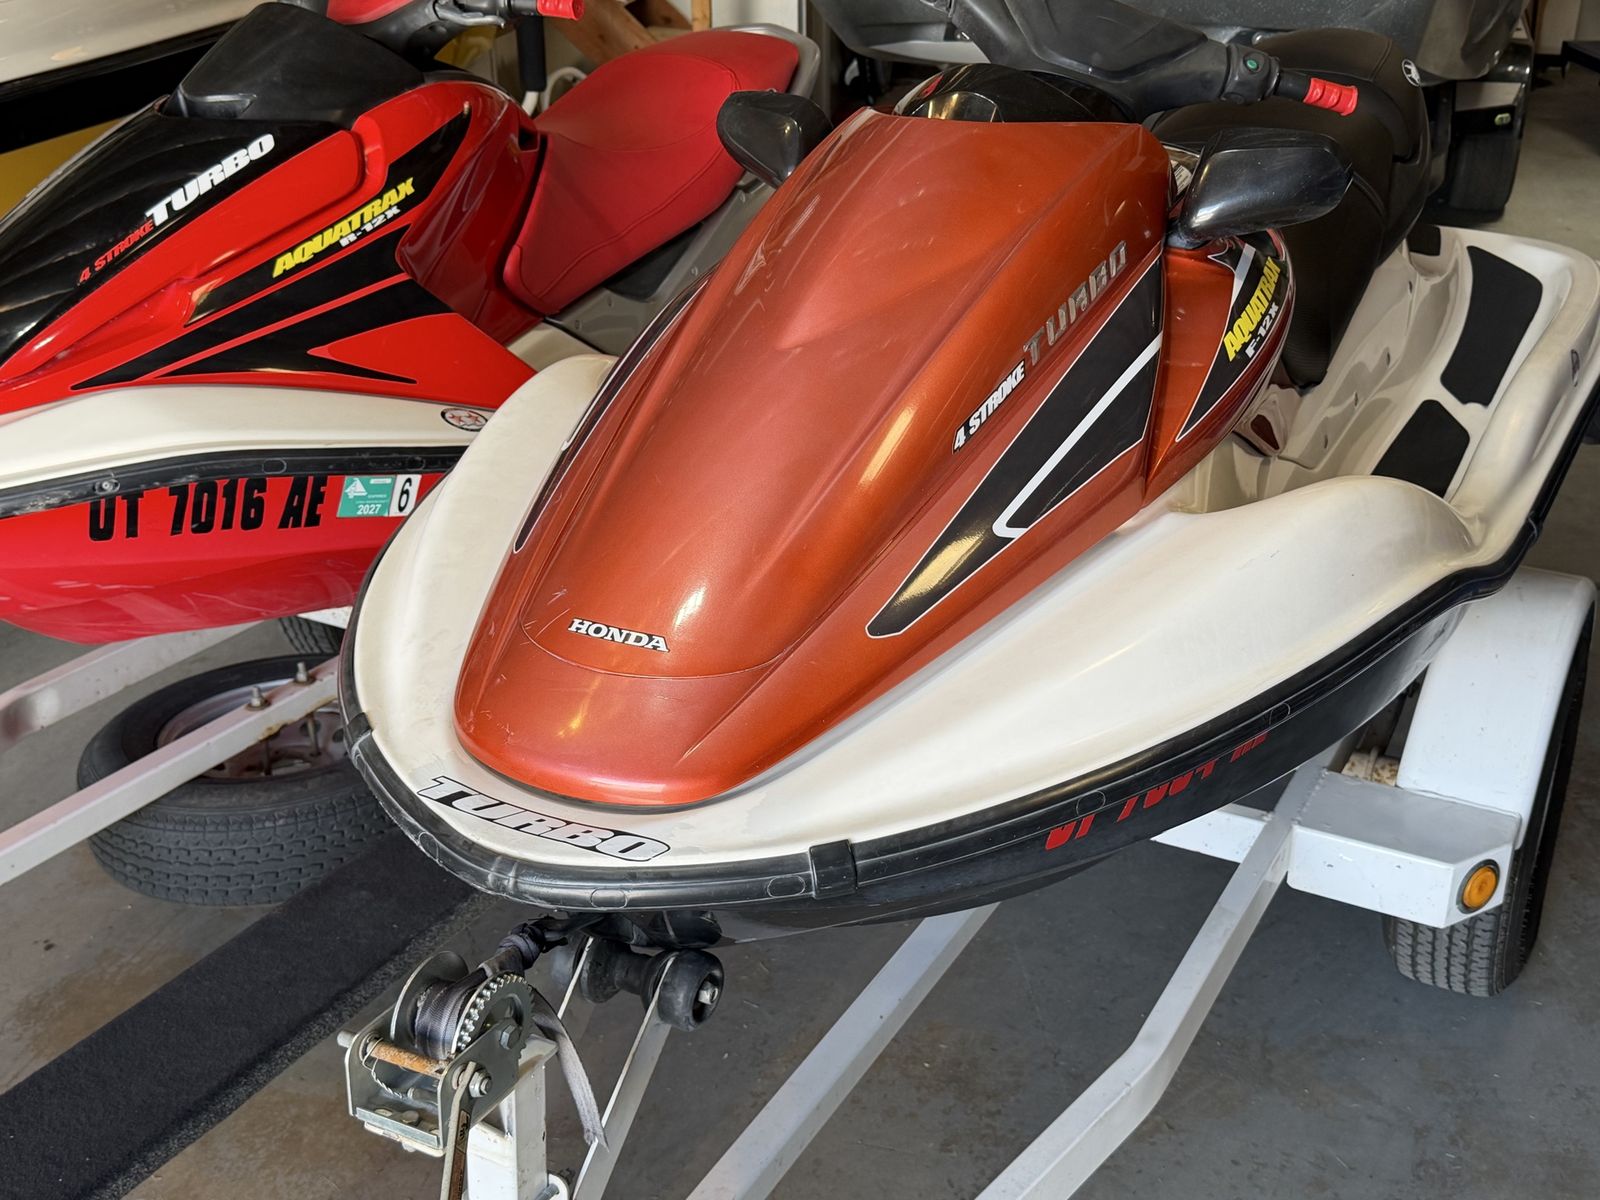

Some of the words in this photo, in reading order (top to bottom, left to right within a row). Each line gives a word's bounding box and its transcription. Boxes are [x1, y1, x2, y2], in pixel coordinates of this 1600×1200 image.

[79, 267, 92, 283] 4
[94, 219, 154, 272] STROKE
[145, 133, 275, 227] TURBO
[272, 177, 416, 279] AQUATRAX
[338, 205, 401, 248] R-12X
[1224, 256, 1281, 362] AQUATRAX
[1245, 302, 1279, 358] F-12X
[953, 425, 967, 451] 4
[968, 360, 1026, 436] STROKE
[1022, 240, 1128, 367] TURBO
[89, 491, 144, 541] UT
[168, 478, 267, 536] 7016
[277, 476, 328, 529] AE
[356, 503, 382, 515] 2027
[398, 477, 413, 512] 6
[567, 618, 670, 653] HONDA
[417, 775, 671, 862] TURBO
